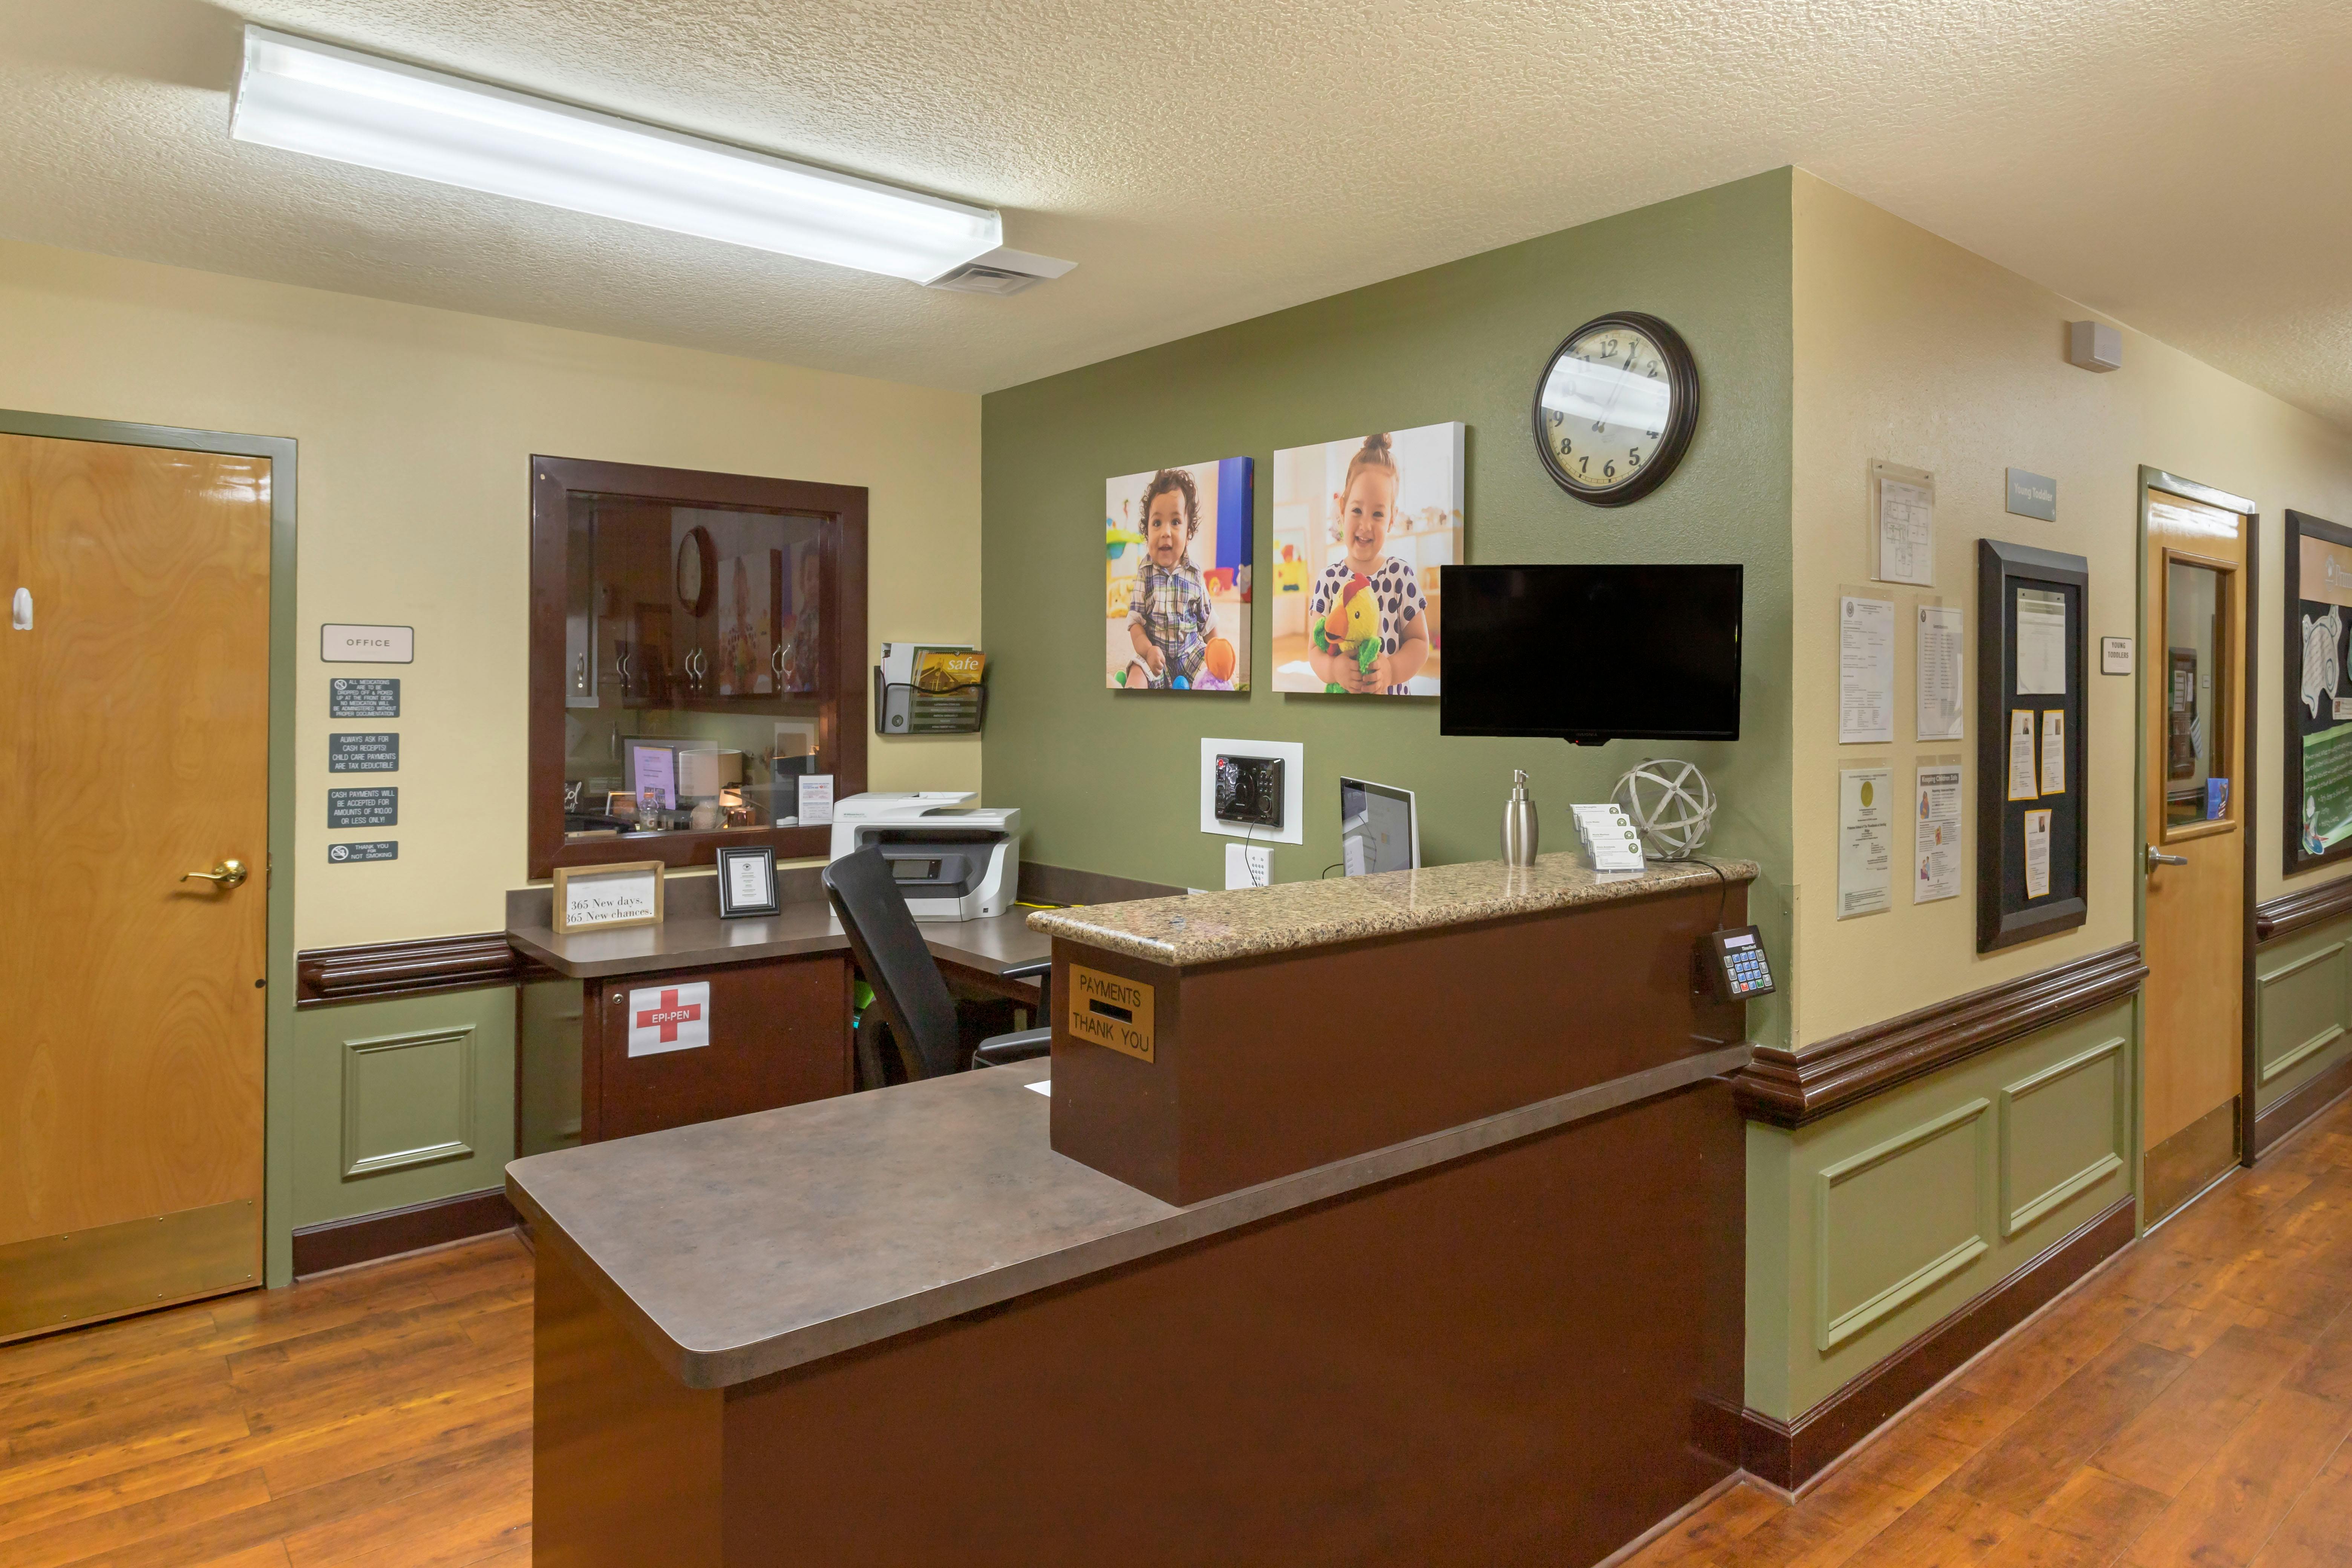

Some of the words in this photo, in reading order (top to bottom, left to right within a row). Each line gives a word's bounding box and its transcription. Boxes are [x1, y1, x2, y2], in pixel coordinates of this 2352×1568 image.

[1600, 339, 1618, 358] 12
[1647, 360, 1658, 378] 2
[1553, 410, 1564, 427] 9
[1646, 421, 1659, 439] 4
[1560, 438, 1572, 455] 8
[1579, 456, 1589, 473] 7
[1629, 447, 1640, 466] 5
[1603, 460, 1615, 478] 6
[2014, 482, 2032, 500] Young
[2032, 487, 2053, 502] Toddler
[947, 656, 978, 670] safe
[571, 900, 589, 910] 365
[592, 898, 614, 908] New
[566, 913, 582, 923] 365
[586, 911, 608, 922] New
[611, 909, 652, 919] chances.
[1080, 974, 1141, 1008] PAYMENTS
[652, 1010, 690, 1023] EPI-PEN
[1073, 1012, 1114, 1041] THANK
[1121, 1027, 1149, 1052] YOU
